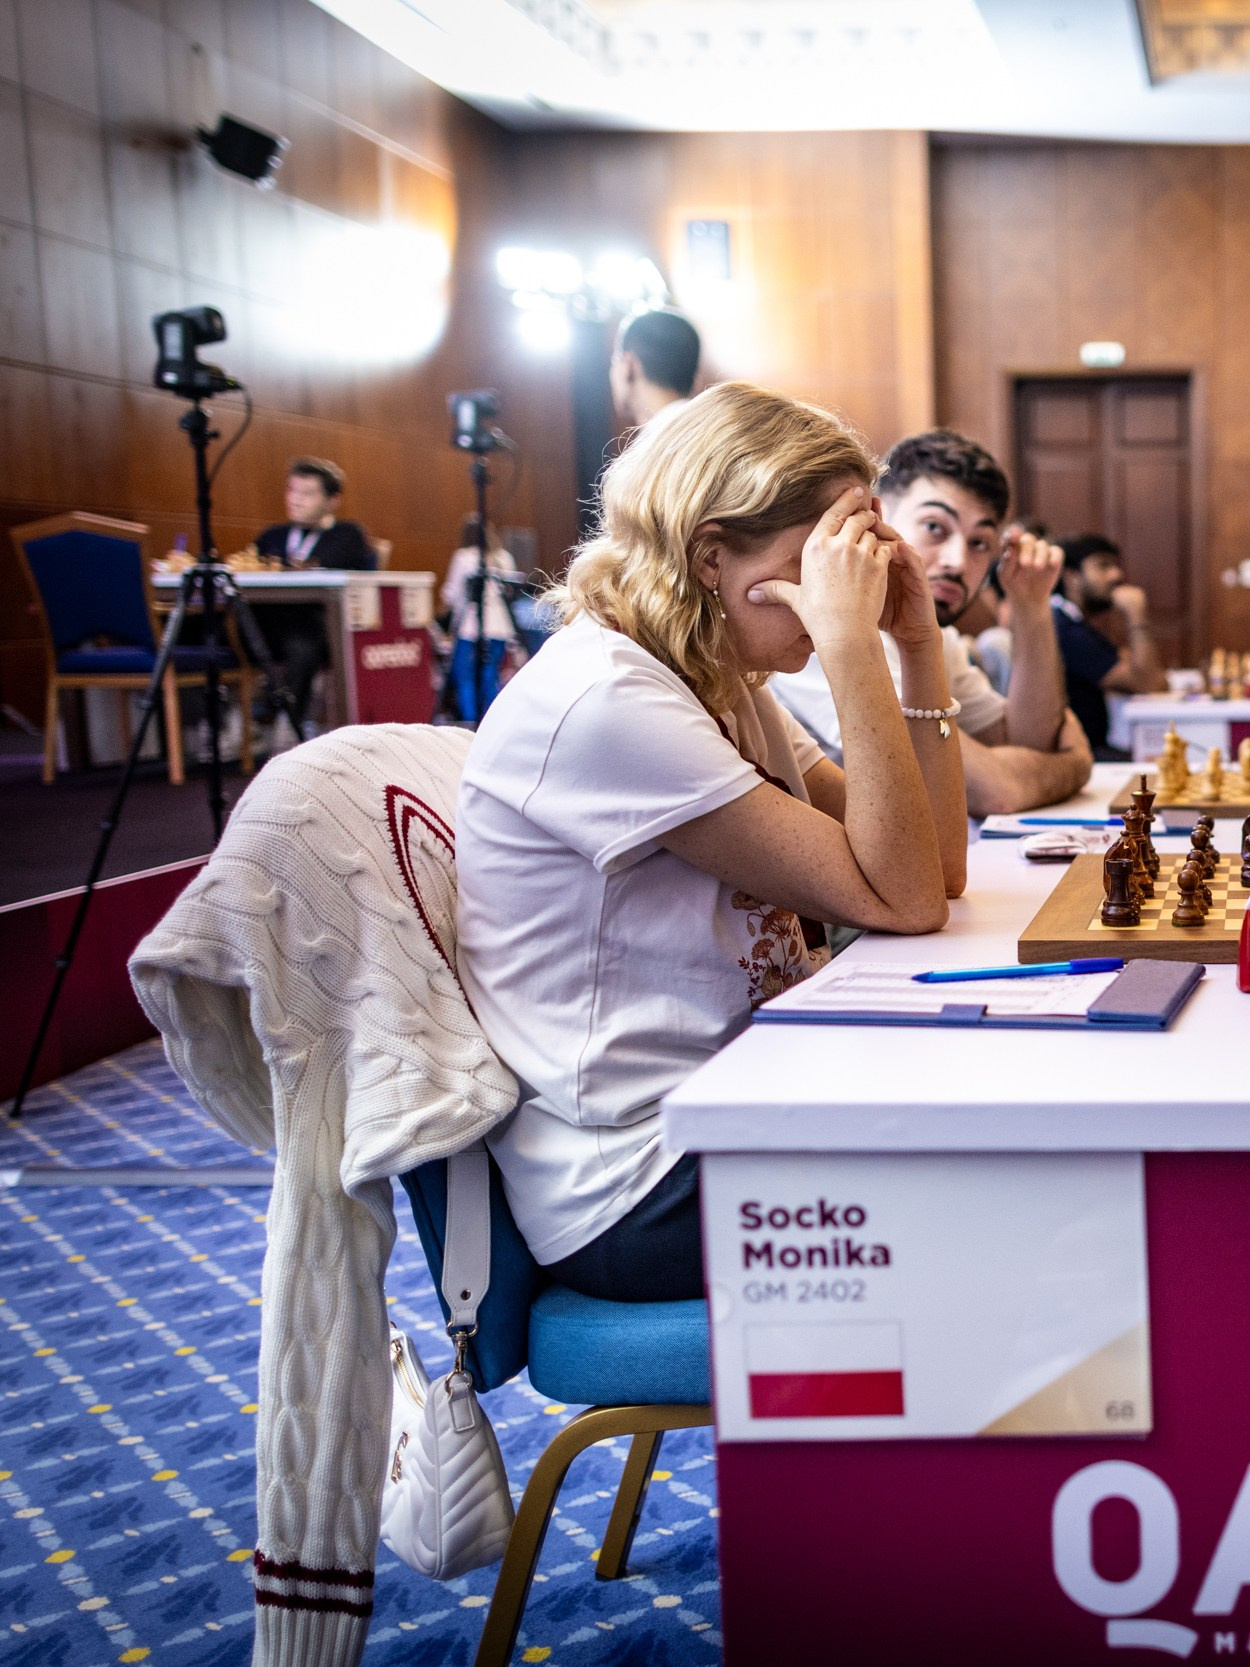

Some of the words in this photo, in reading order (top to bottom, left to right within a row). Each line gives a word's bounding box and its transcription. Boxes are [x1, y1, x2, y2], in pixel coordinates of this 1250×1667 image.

[740, 1197, 867, 1231] Socko
[742, 1237, 892, 1270] Monika
[743, 1281, 787, 1303] GM
[798, 1280, 866, 1303] 2402
